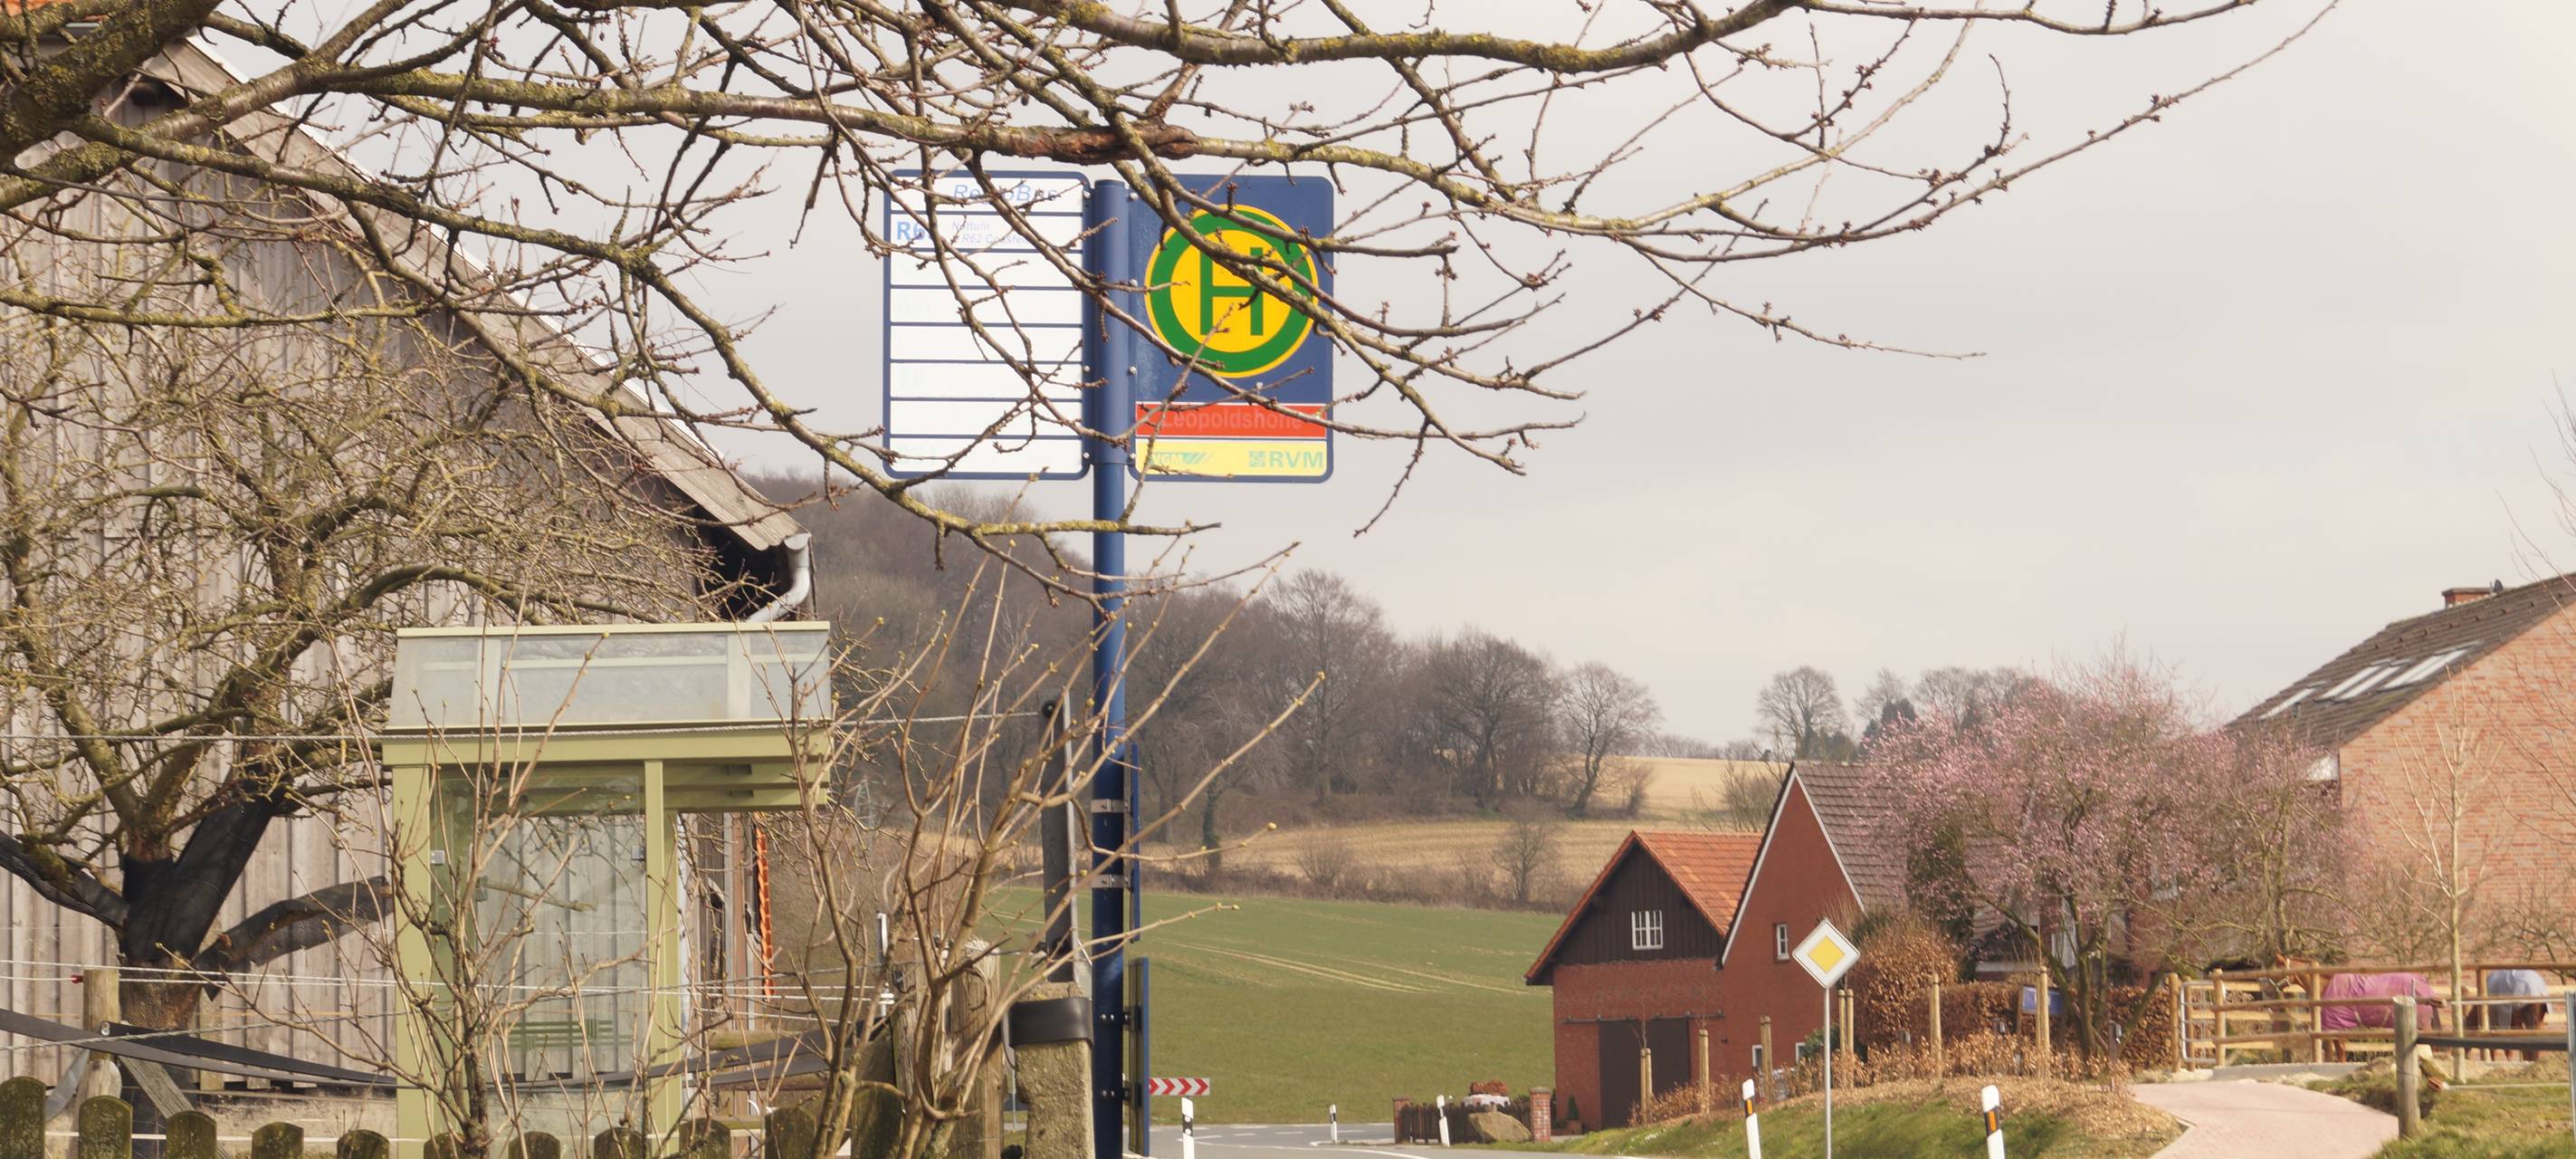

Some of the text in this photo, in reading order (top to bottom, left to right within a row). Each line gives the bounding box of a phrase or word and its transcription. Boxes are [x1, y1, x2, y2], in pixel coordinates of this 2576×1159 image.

[897, 221, 937, 241] R6
[1200, 247, 1264, 336] H
[1269, 451, 1323, 468] RVM
